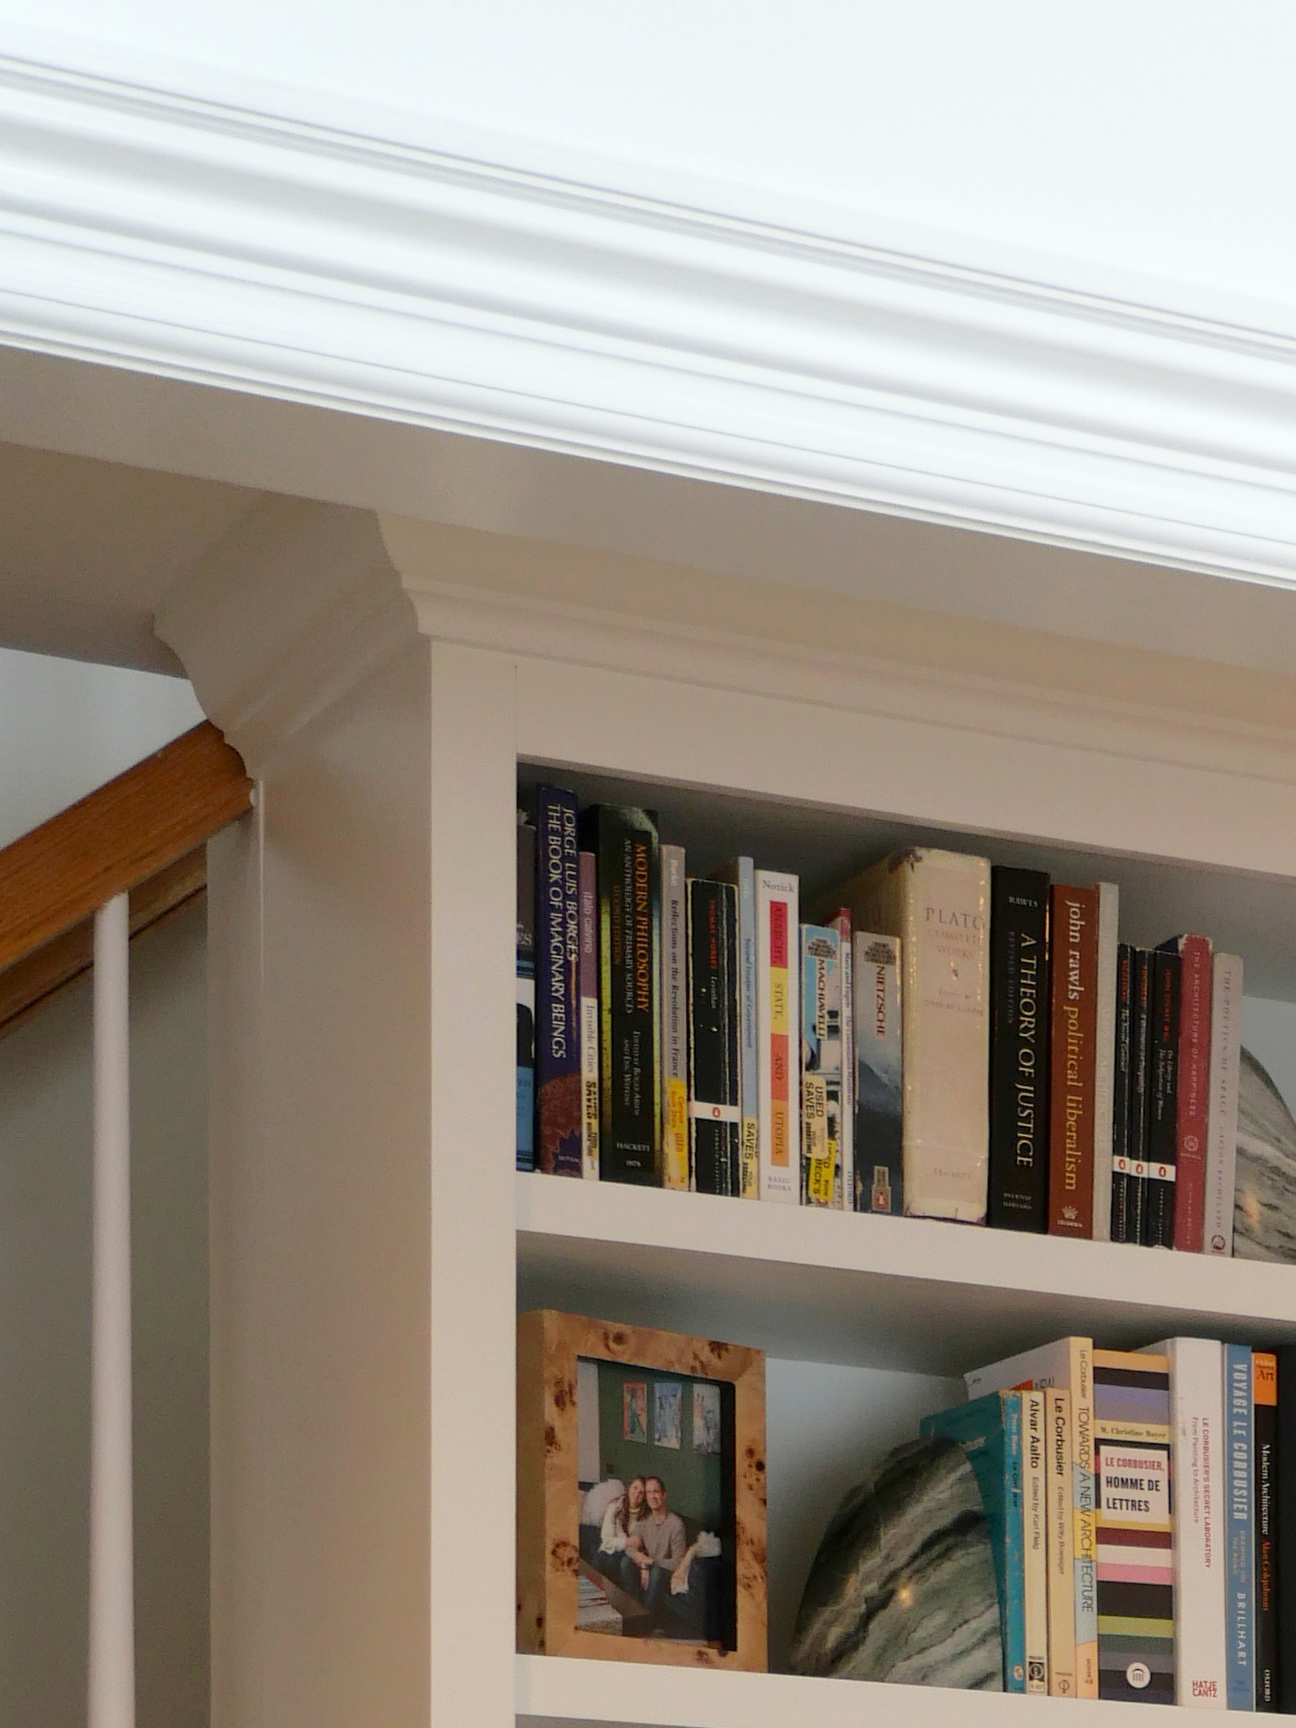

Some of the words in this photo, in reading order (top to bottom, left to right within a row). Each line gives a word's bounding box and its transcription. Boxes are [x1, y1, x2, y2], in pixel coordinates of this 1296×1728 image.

[549, 804, 561, 832] THE
[564, 807, 577, 856] JORGE
[550, 835, 563, 884] BOOK
[565, 861, 577, 894] LUIS
[550, 887, 563, 909] OF
[1065, 900, 1083, 943] john
[566, 901, 578, 961] BORGES
[1021, 935, 1034, 948] A
[550, 913, 565, 1000] IMAGINARY
[1067, 950, 1083, 1000] rawls
[817, 959, 827, 1038] MACHIAVELLI
[876, 966, 885, 1037] NIETZSCHE
[1018, 955, 1036, 1040] THEORY
[552, 1004, 565, 1058] BEINGS
[1064, 1005, 1085, 1086] political
[1018, 1049, 1036, 1077] OF
[1015, 1082, 1035, 1166] JUSTICE
[1065, 1095, 1082, 1190] liberalism
[1028, 1399, 1040, 1432] Alvar
[1054, 1398, 1065, 1412] Le
[1029, 1435, 1041, 1468] Aalto
[1055, 1416, 1066, 1476] Corbusier
[1077, 1407, 1090, 1469] TOWARDS
[1079, 1473, 1090, 1482] A
[1080, 1487, 1090, 1514] NEW
[1080, 1519, 1092, 1612] ARCHITECTURE
